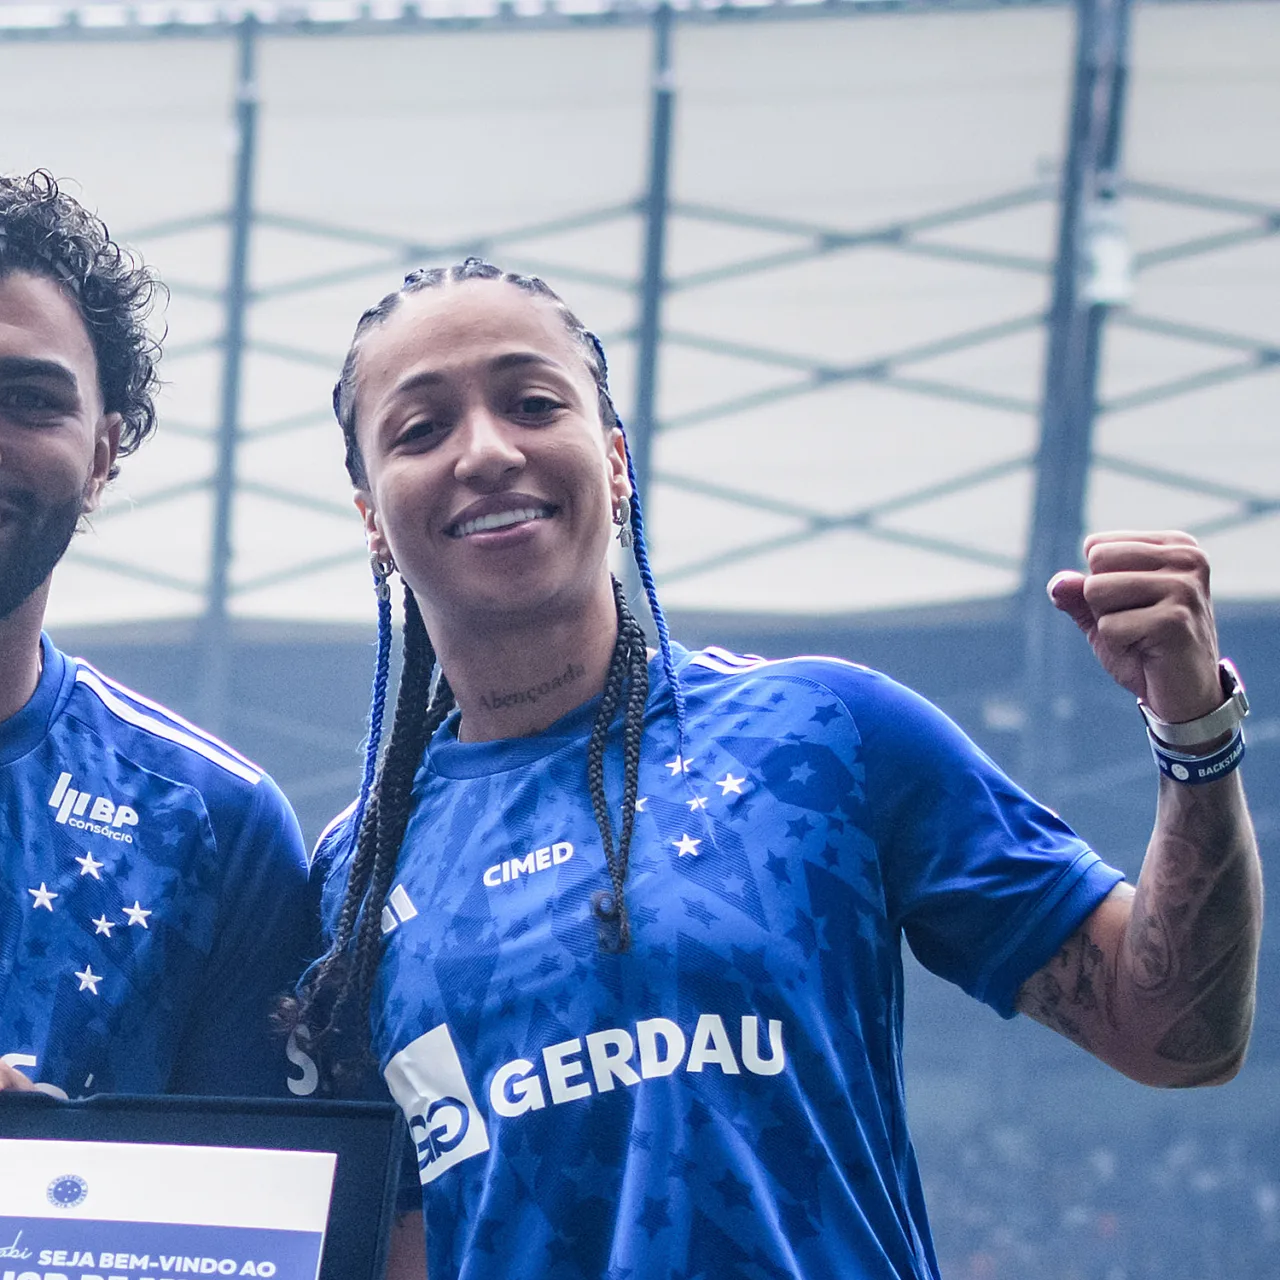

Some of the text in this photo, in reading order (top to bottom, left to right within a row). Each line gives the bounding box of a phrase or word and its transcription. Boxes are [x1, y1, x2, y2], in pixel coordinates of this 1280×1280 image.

[89, 796, 139, 828] BP
[68, 818, 133, 844] consórcio
[483, 841, 573, 887] CIMED
[489, 1014, 785, 1118] GERDAU
[37, 1249, 95, 1268] SEJA
[99, 1252, 237, 1275] BEM-VINDO
[239, 1260, 276, 1278] AO
